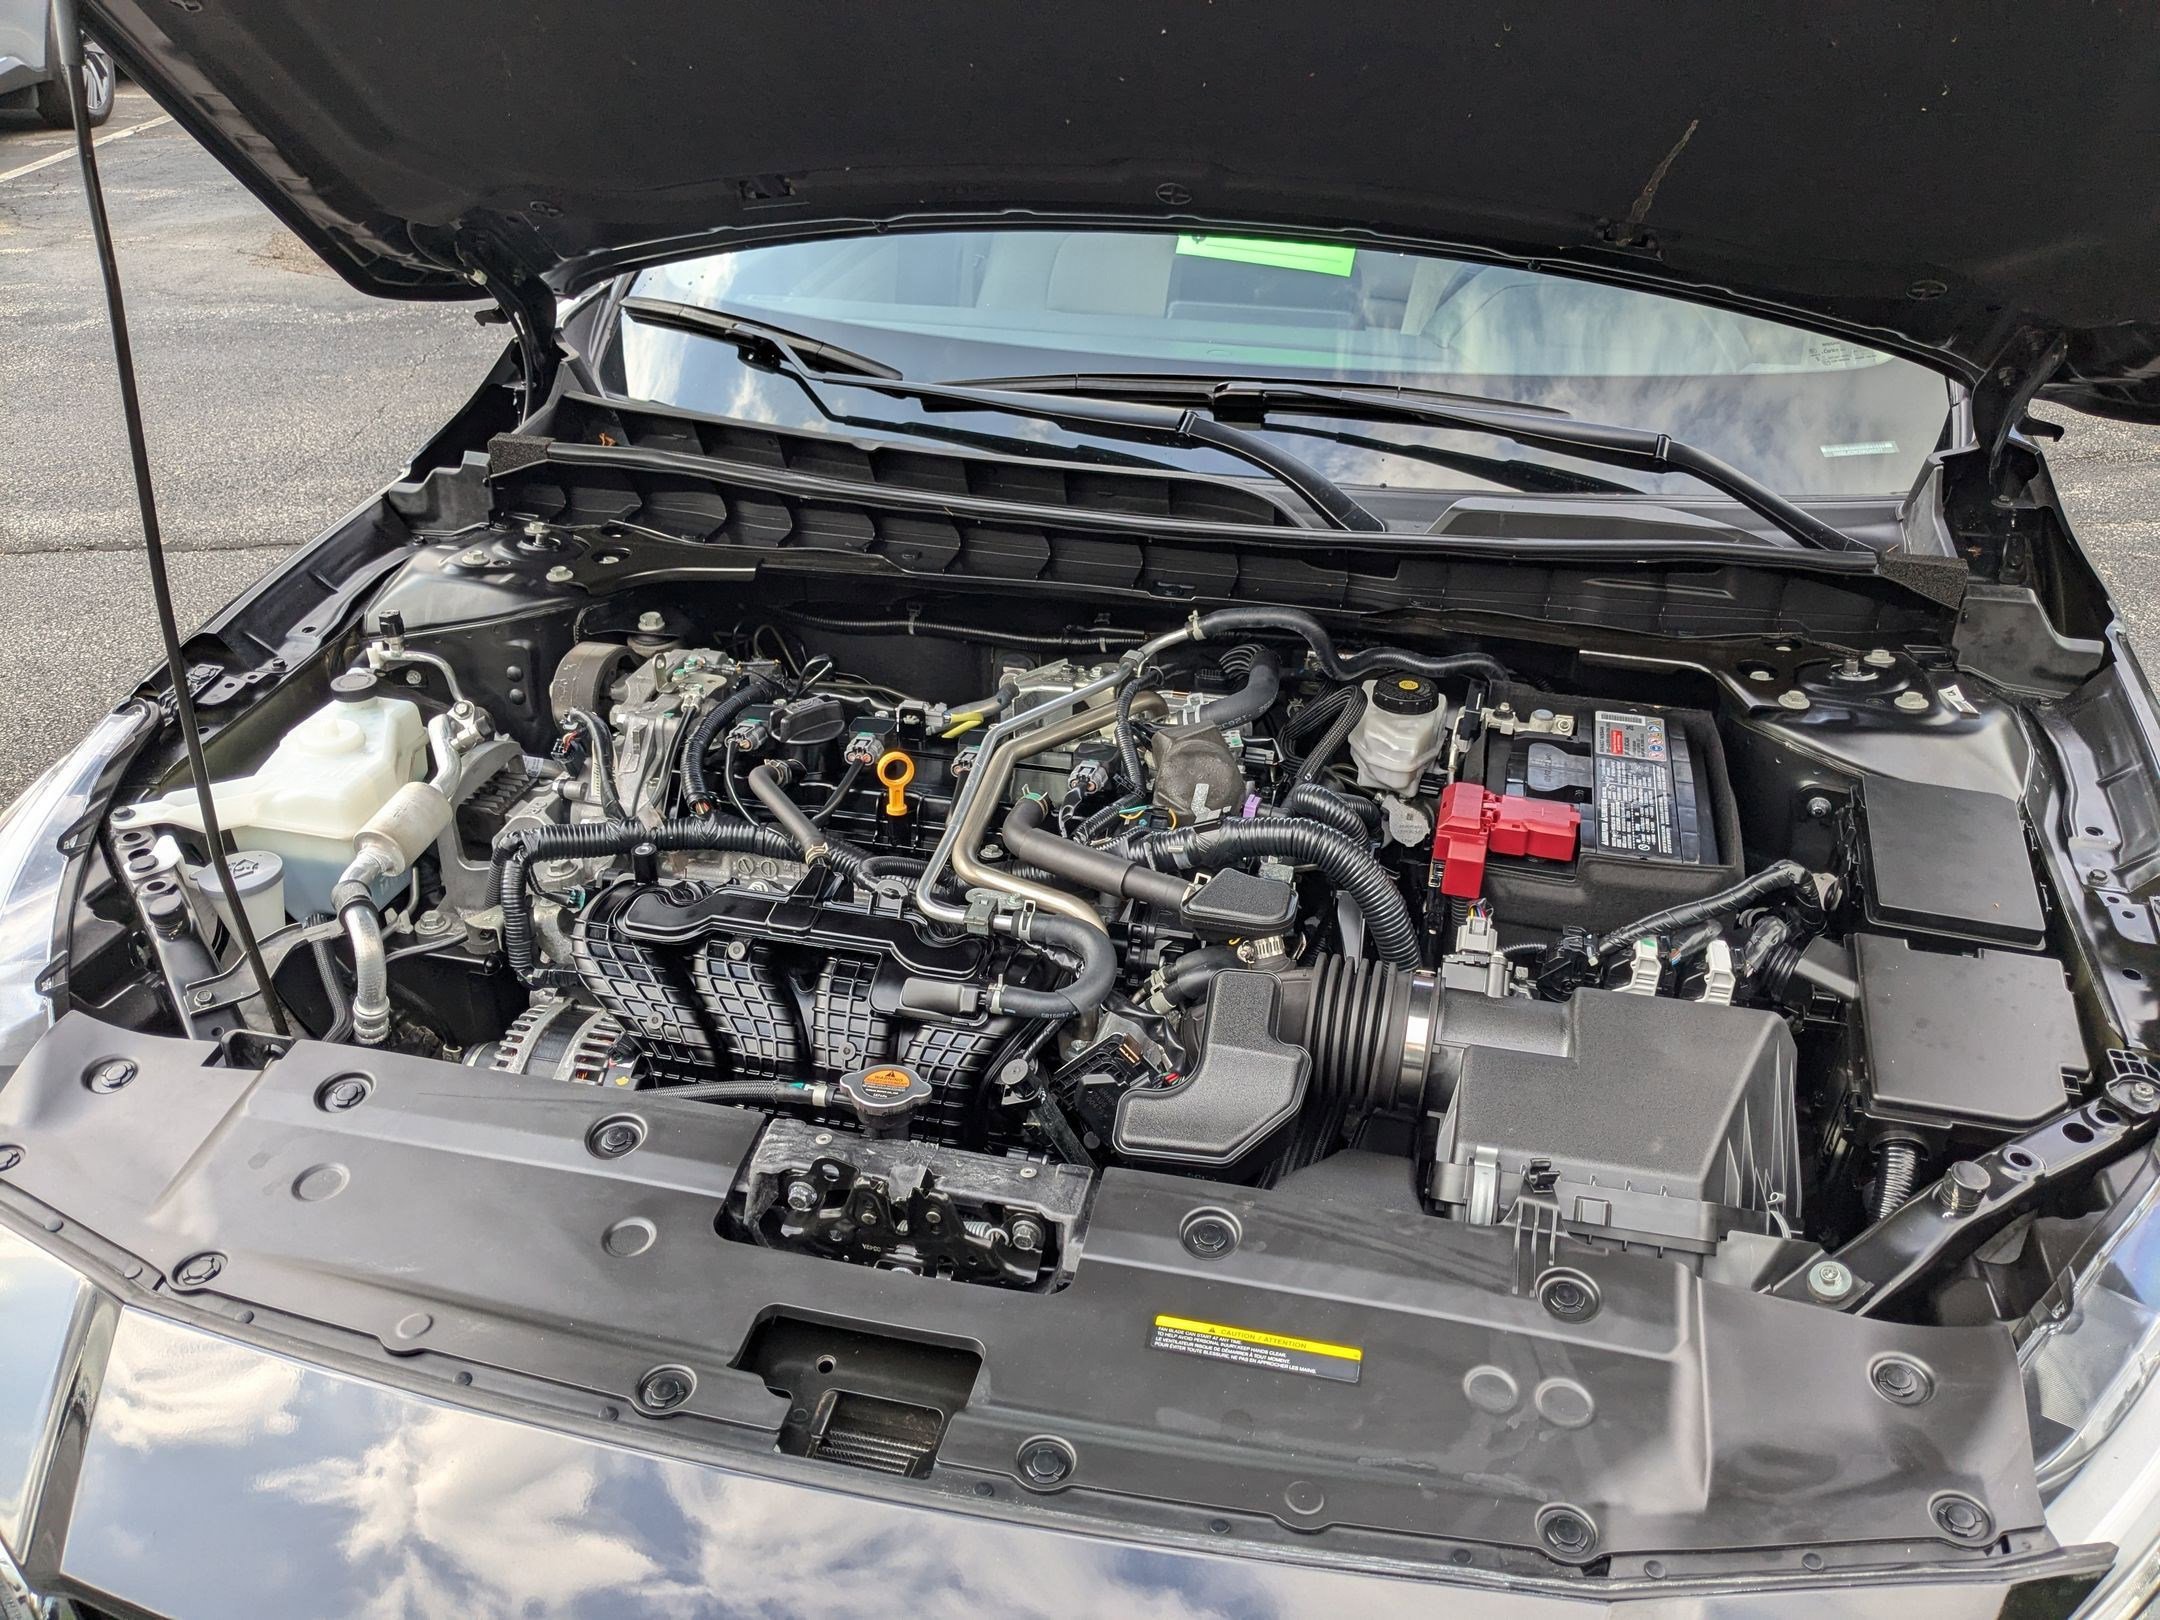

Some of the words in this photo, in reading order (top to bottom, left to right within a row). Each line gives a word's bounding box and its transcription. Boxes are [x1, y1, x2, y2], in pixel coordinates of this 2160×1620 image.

[1162, 1337, 1194, 1347] VENTILATEUR
[1194, 1342, 1213, 1351] RISQUE
[1221, 1346, 1249, 1357] DÉMARRER
[1193, 1336, 1219, 1346] PERSONAL
[1250, 1347, 1269, 1355] HANDS
[1219, 1335, 1230, 1343] ANY
[1220, 1329, 1256, 1340] CAUTION
[1263, 1336, 1307, 1349] ATTENTION
[1169, 1343, 1186, 1351] ÉVITER
[1186, 1346, 1203, 1354] TOUTE
[1257, 1359, 1289, 1370] APPROCHER
